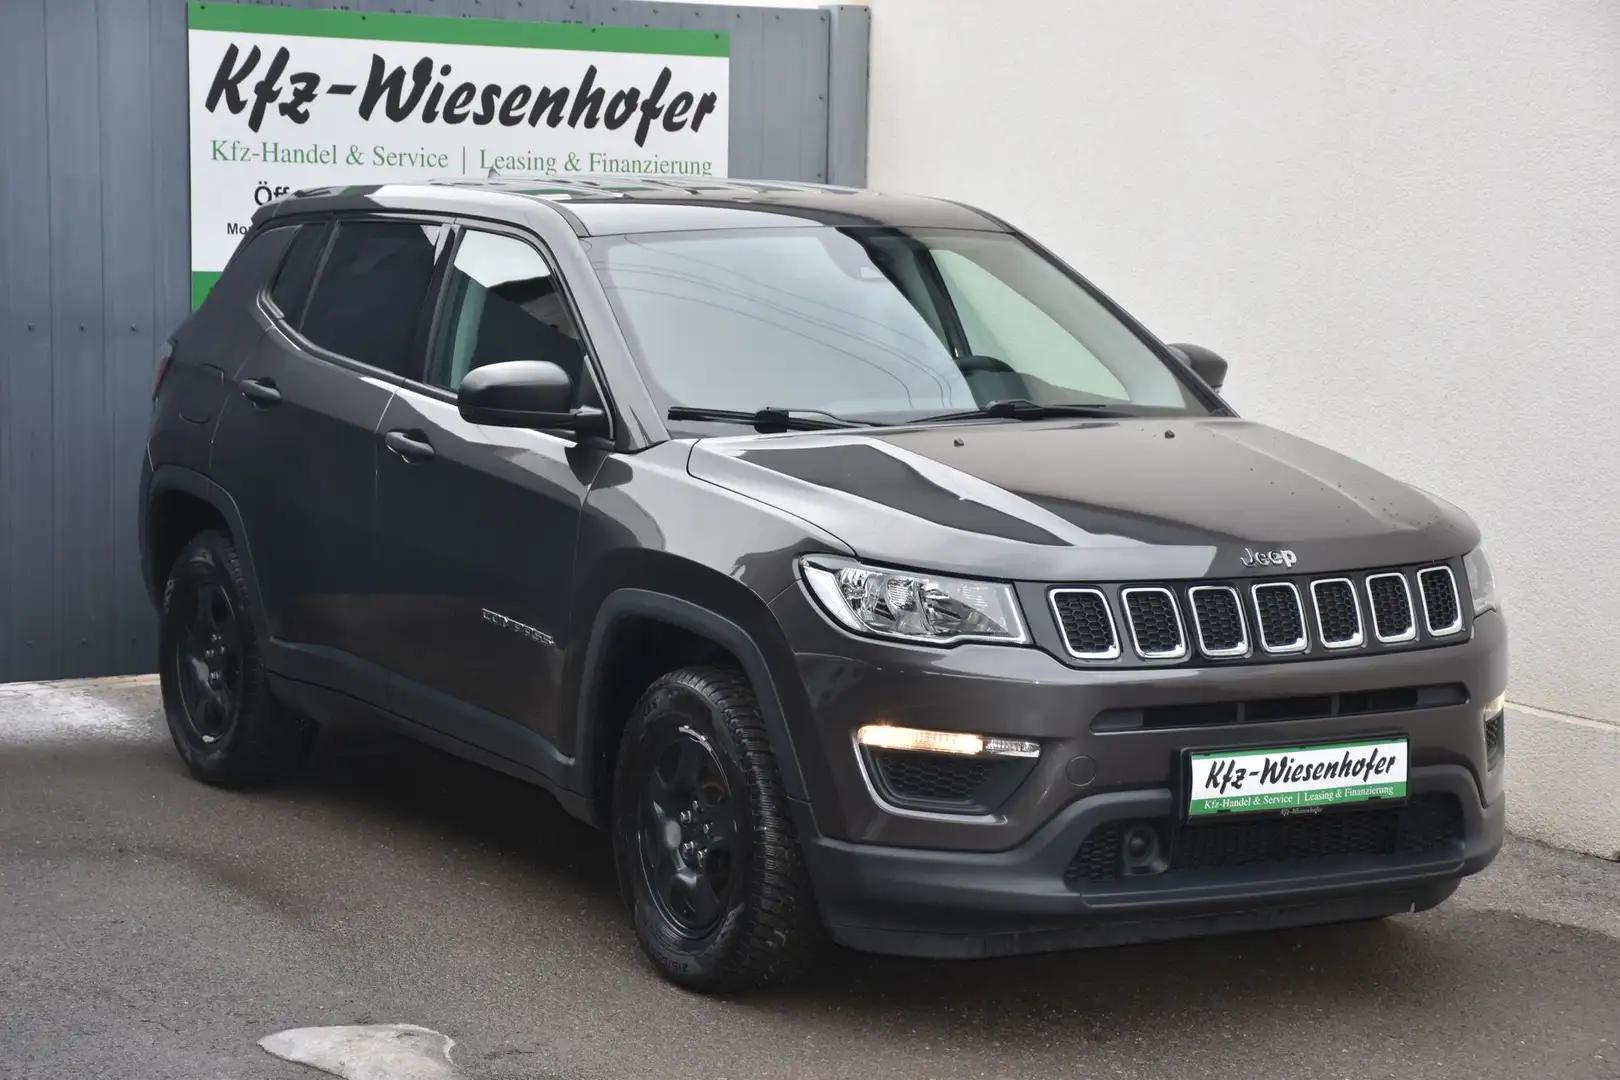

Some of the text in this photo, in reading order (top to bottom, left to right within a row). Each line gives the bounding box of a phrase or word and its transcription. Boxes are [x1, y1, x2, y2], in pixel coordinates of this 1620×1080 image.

[205, 43, 717, 147] Kfz-Wiesenhofer
[210, 140, 713, 177] Kfz-Handel & Service Leasing & Finanzierung
[227, 223, 252, 235] Mo
[1240, 548, 1297, 567] Jeep
[1205, 748, 1396, 794] Kfz-Wiesenhofer
[1204, 785, 1394, 810] Kfz-Handel & Service Leasing & Finanzierung
